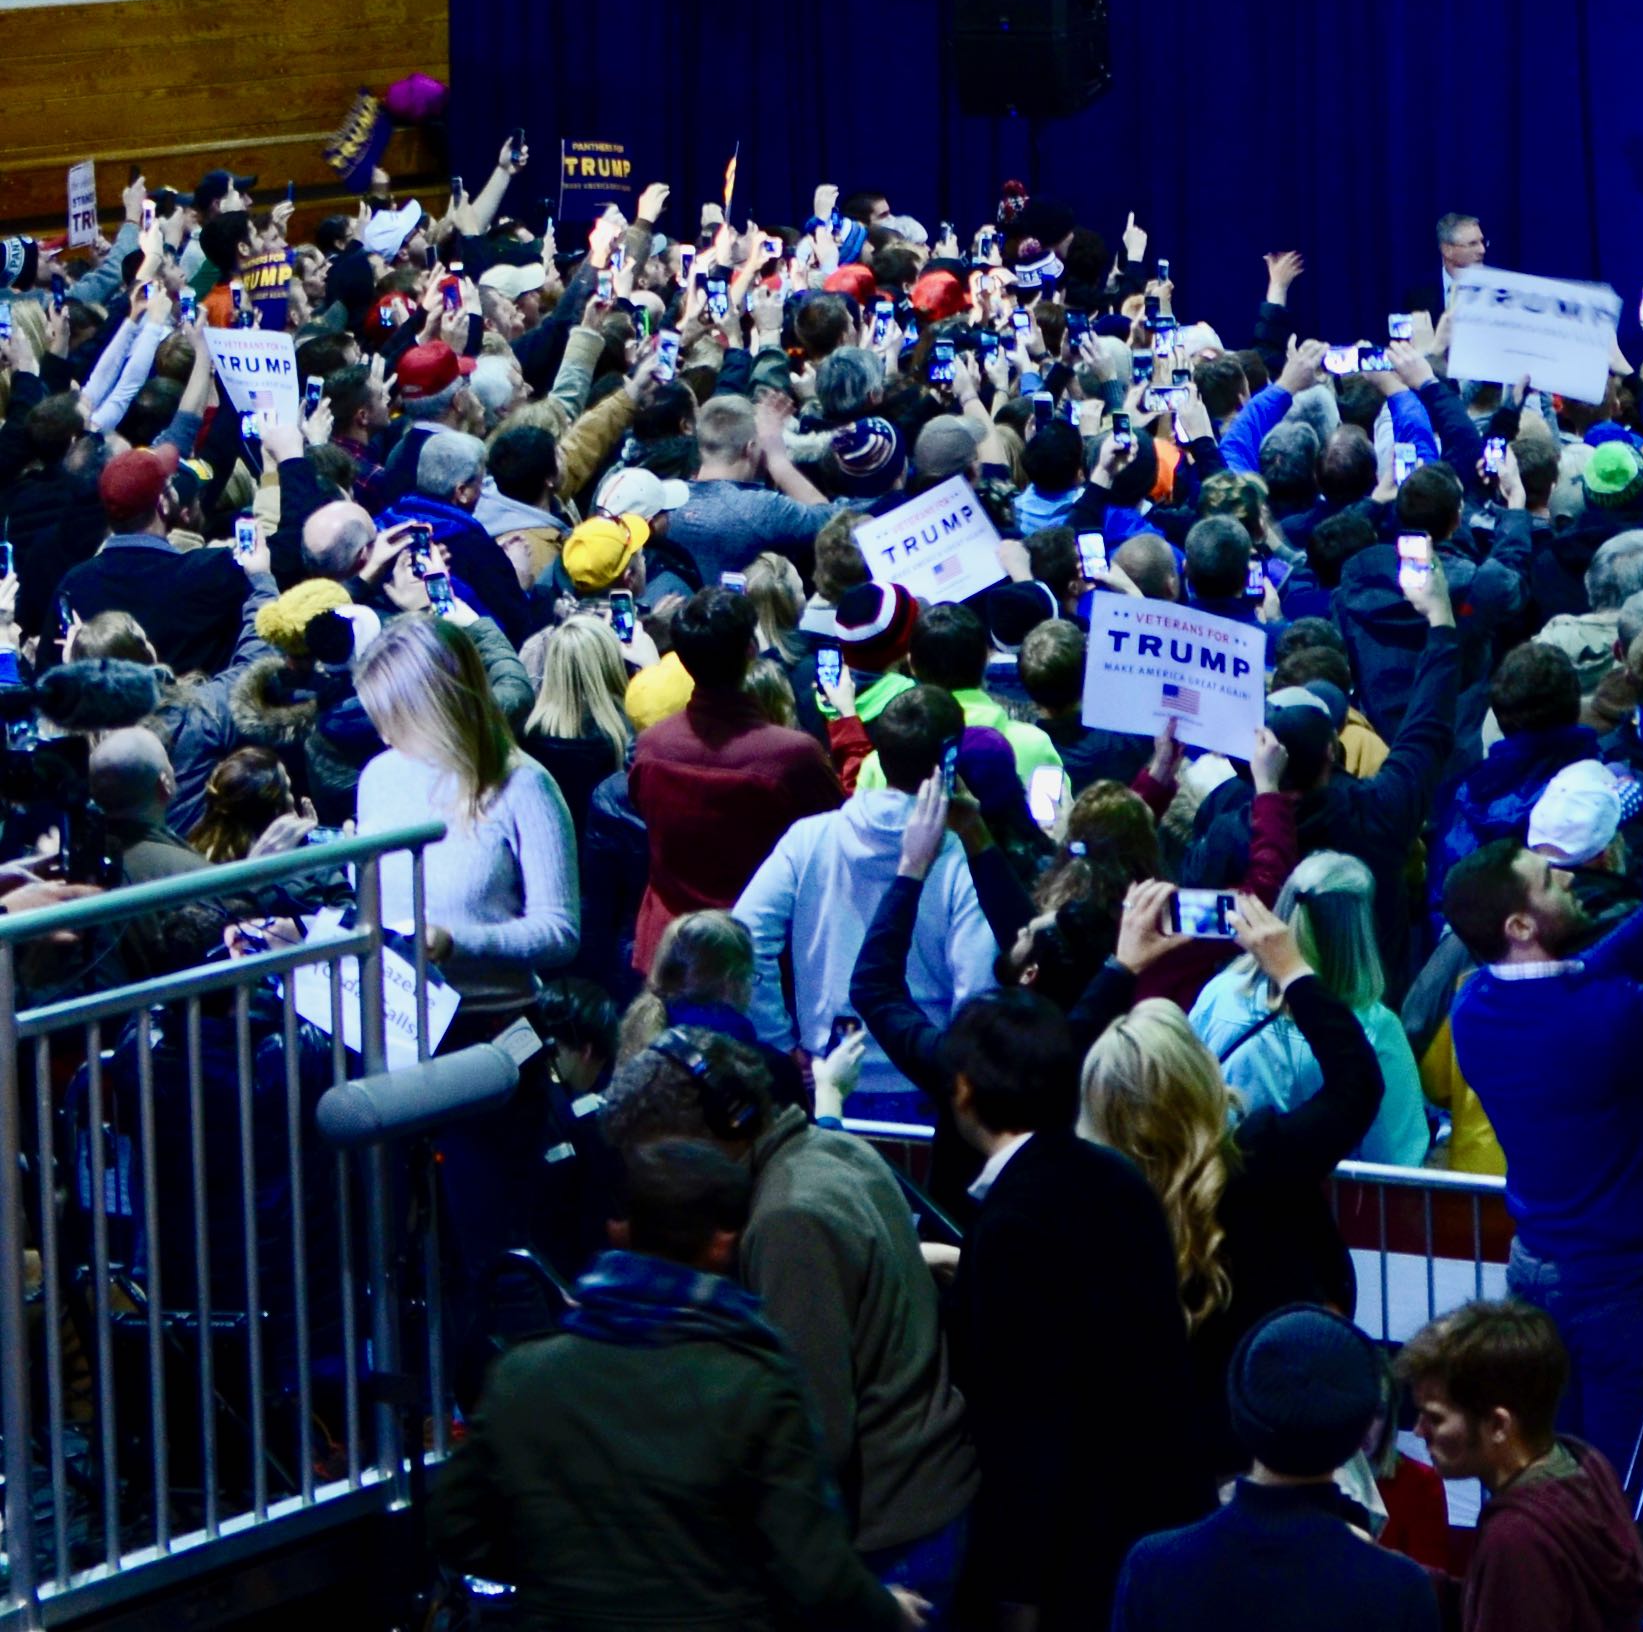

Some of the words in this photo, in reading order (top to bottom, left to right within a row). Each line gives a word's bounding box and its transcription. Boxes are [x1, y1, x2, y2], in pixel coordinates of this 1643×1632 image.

[564, 157, 630, 178] TRUMP
[244, 264, 292, 290] UMP
[224, 340, 263, 349] VETERANS
[265, 341, 279, 350] FOR
[217, 354, 291, 374] TRUMP
[881, 506, 972, 564] TRUMP
[1136, 612, 1202, 636] VETERANS
[1207, 629, 1229, 643] FOR
[1108, 630, 1250, 678] TRUMP
[1105, 662, 1133, 674] MAKE
[1139, 667, 1184, 683] AMERICA
[1188, 676, 1216, 690] GREAT
